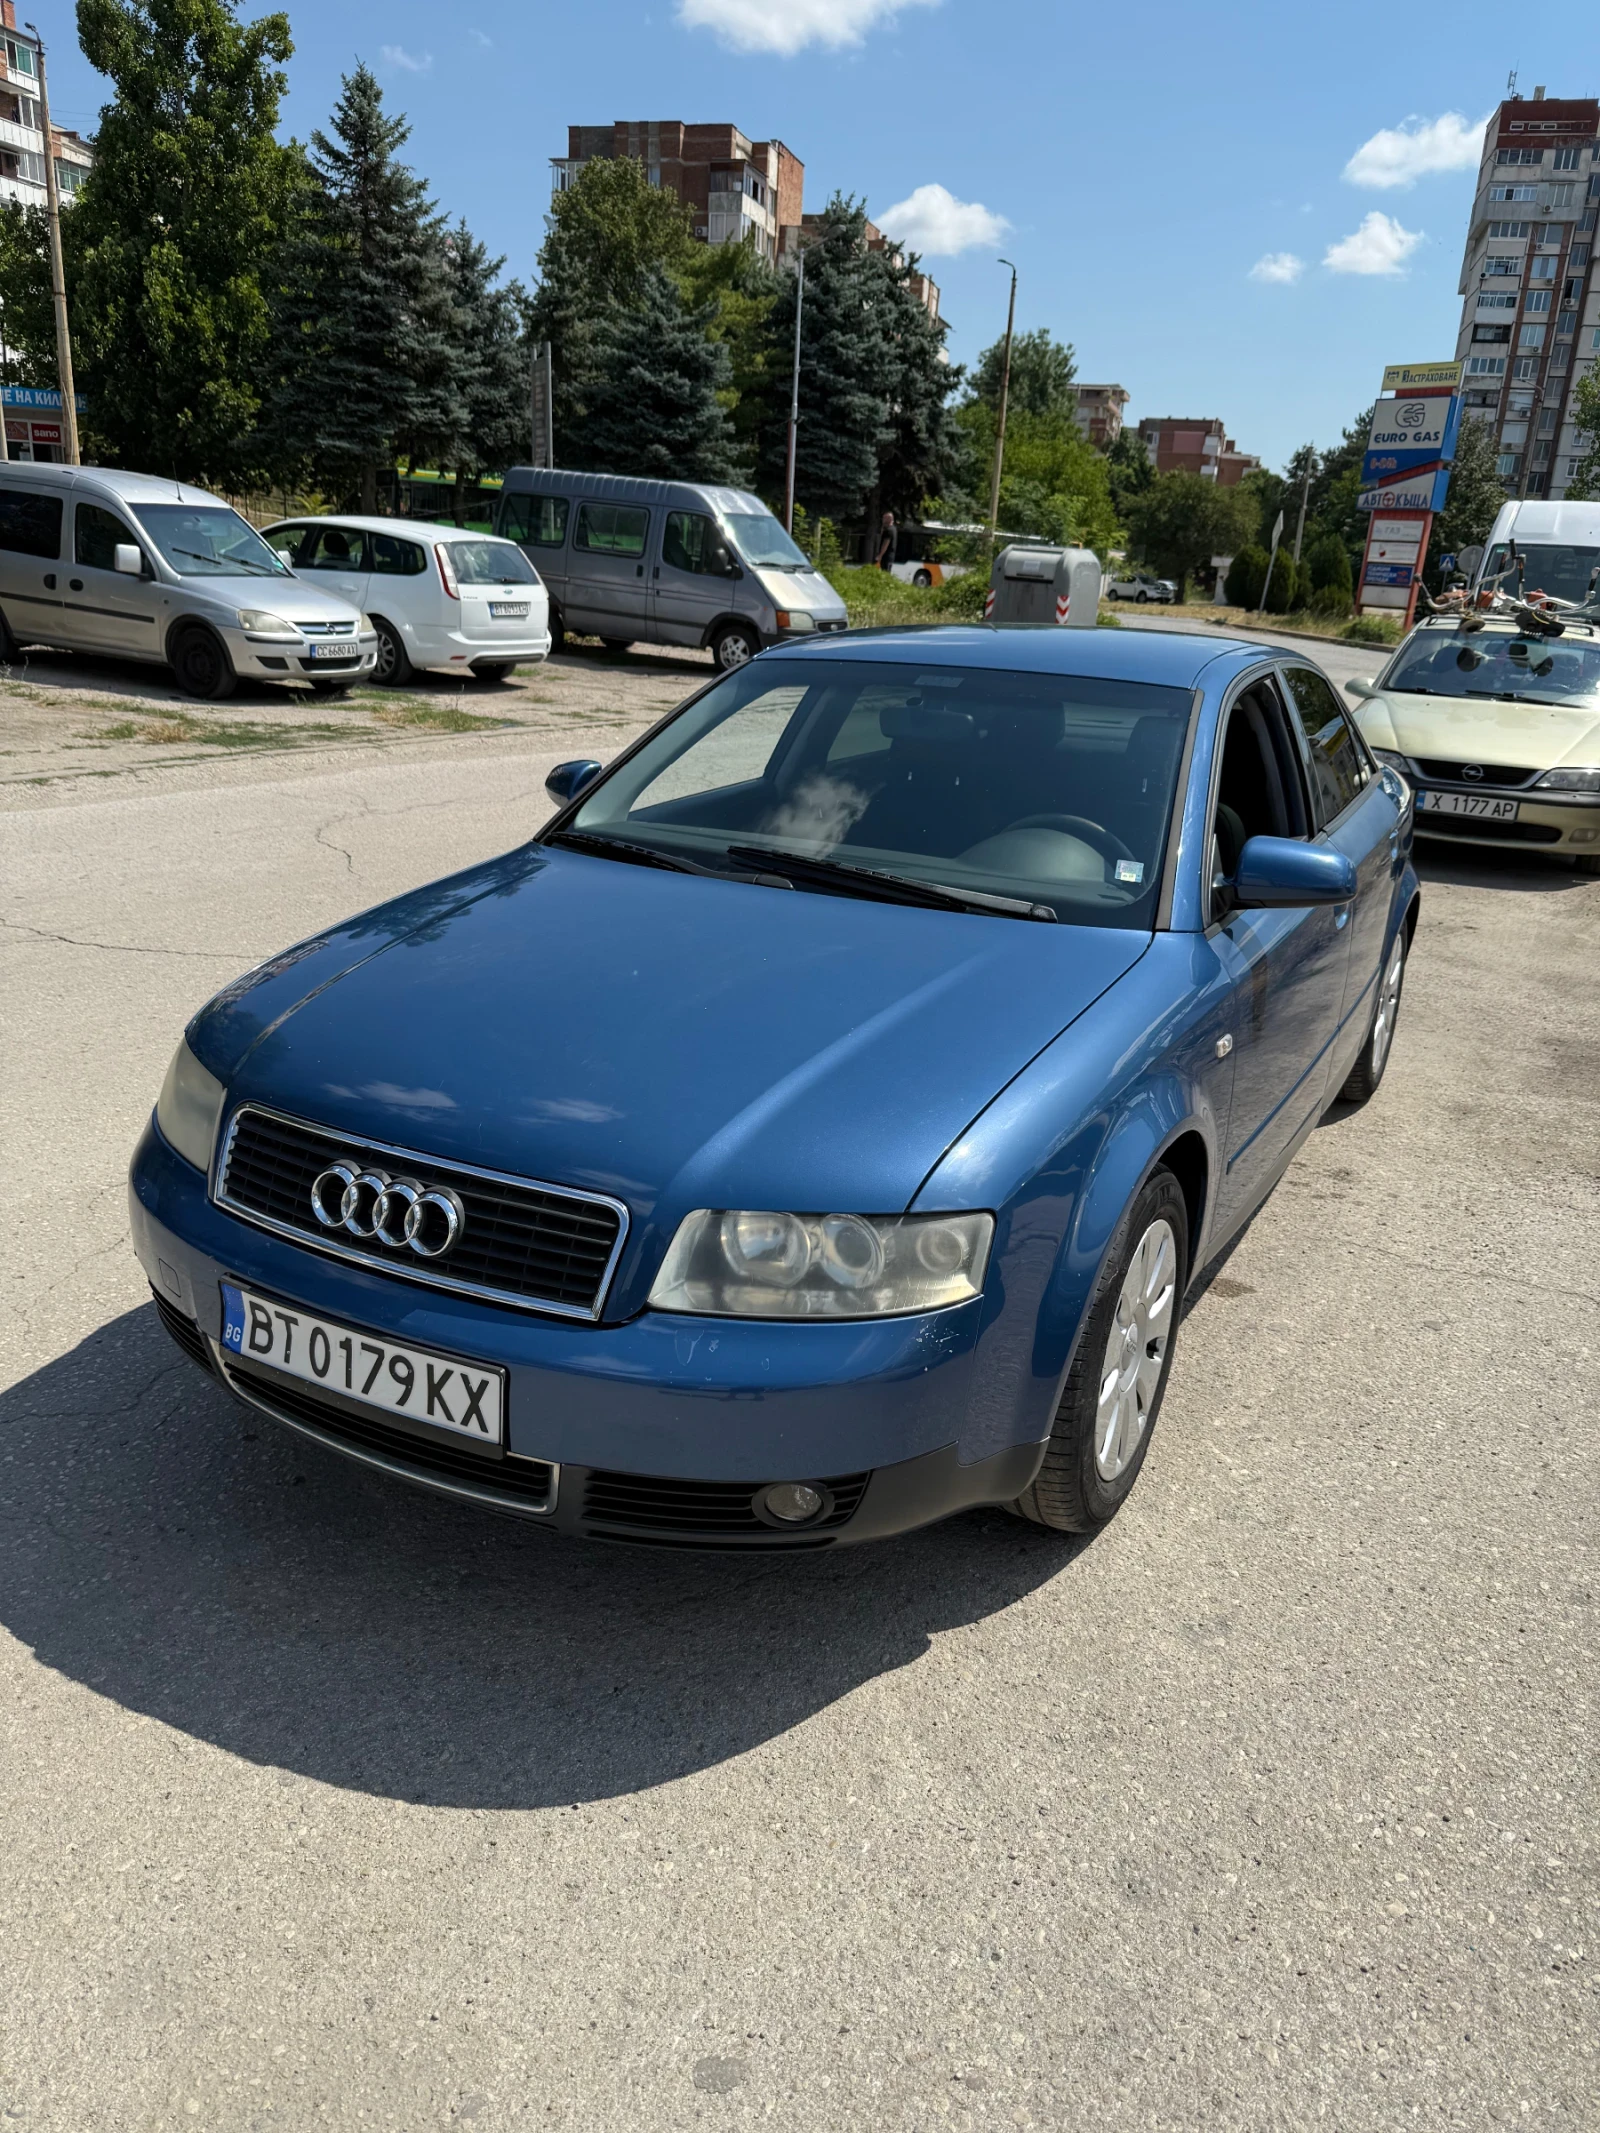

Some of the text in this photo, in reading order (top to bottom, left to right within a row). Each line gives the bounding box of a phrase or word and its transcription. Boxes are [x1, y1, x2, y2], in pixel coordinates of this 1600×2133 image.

[15, 389, 32, 403] НА
[33, 429, 59, 438] sano
[1373, 431, 1440, 443] EURO GAS
[1431, 794, 1514, 817] X 1177 AP
[225, 1323, 241, 1343] BG
